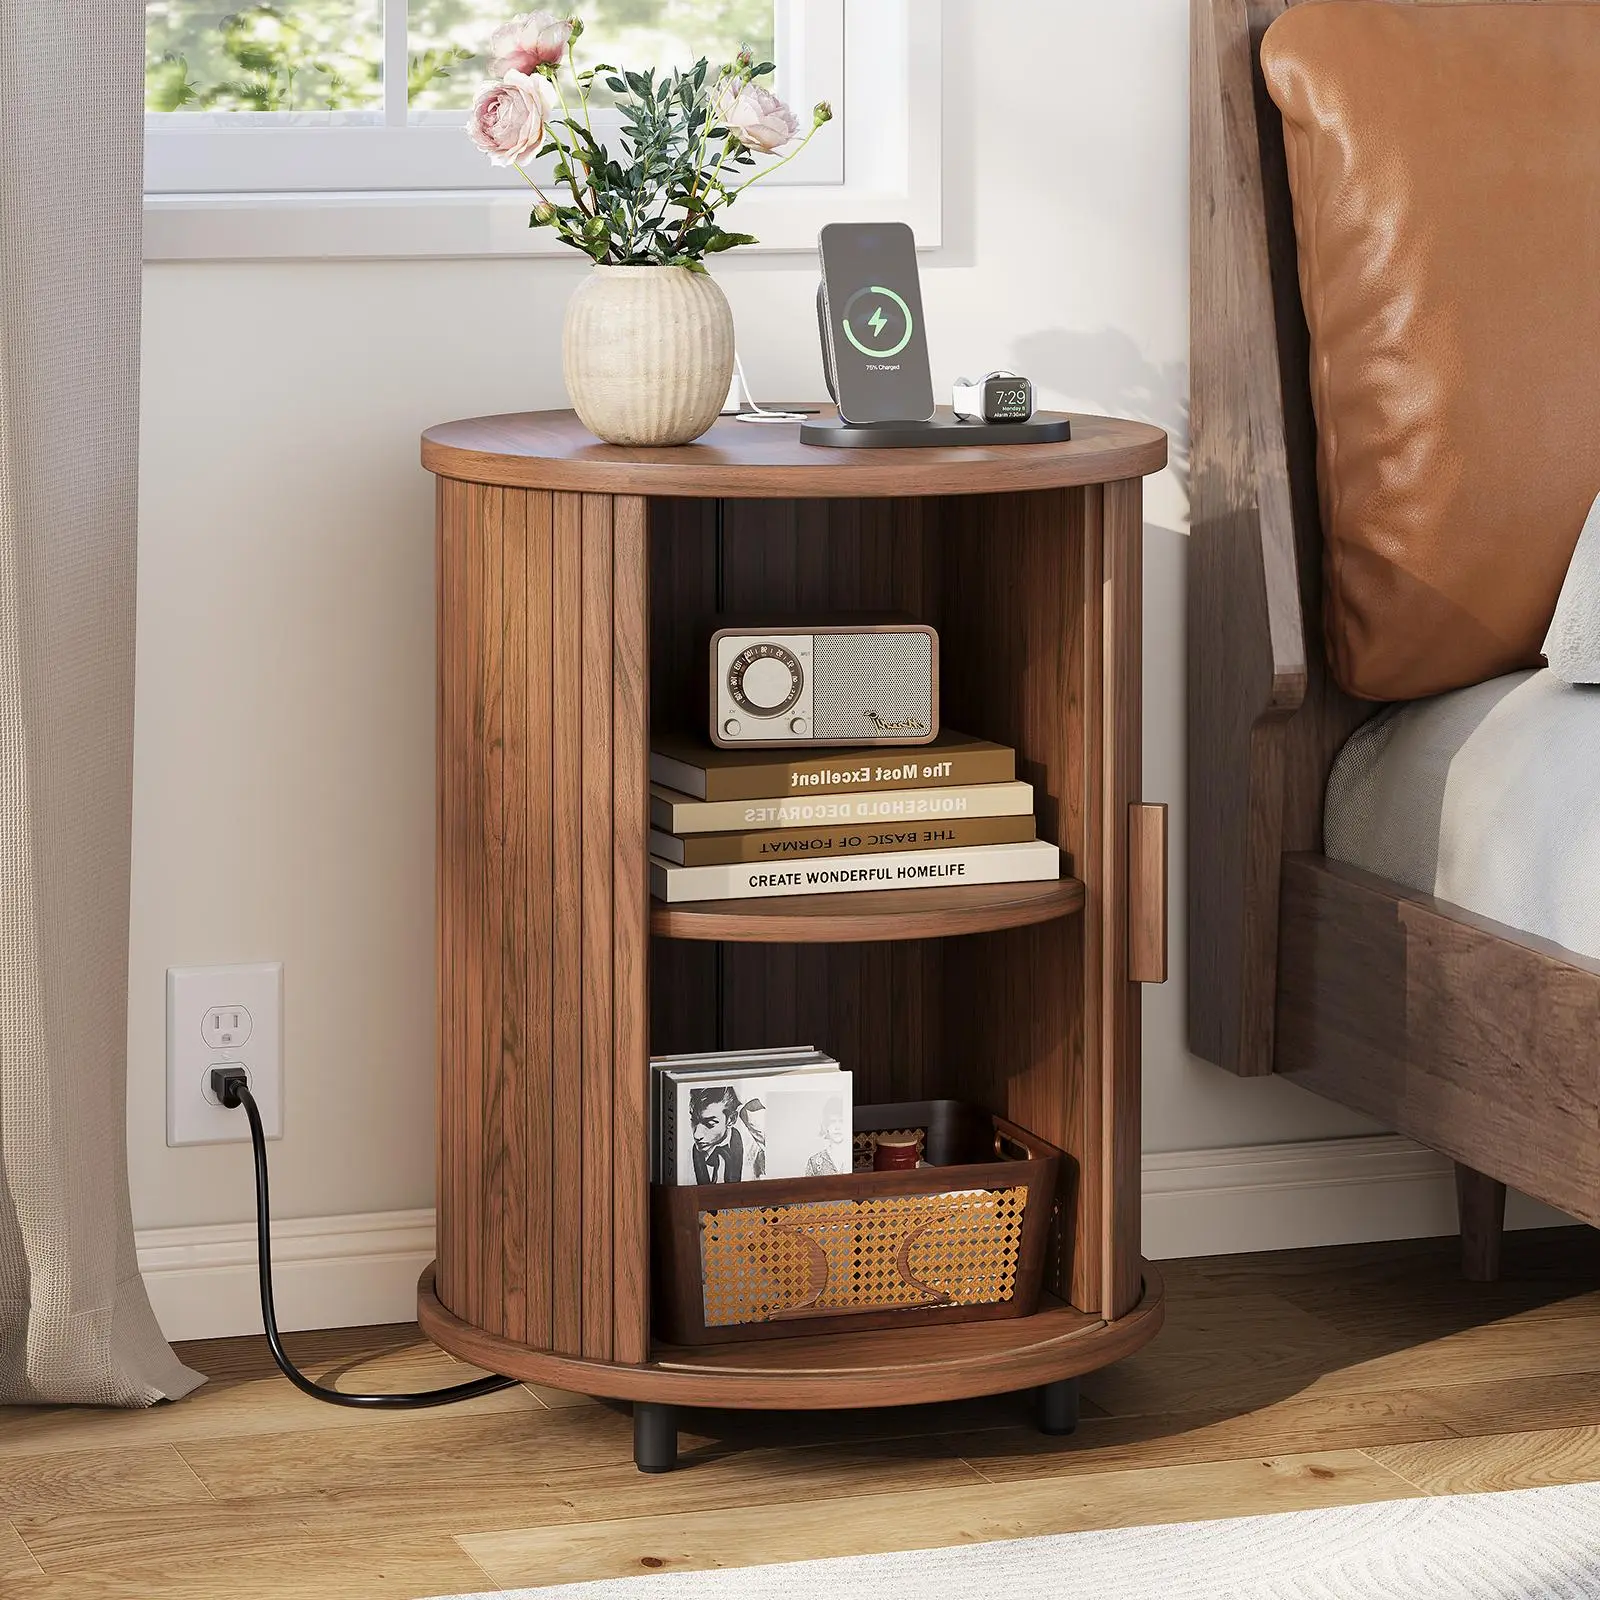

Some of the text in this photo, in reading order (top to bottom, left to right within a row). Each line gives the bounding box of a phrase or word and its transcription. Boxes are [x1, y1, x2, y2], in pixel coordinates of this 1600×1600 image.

[996, 390, 1026, 405] 7:29
[759, 830, 956, 854] THE BASIC OF FORMAT
[749, 863, 966, 888] CREATE WONDERFUL HOMELIFE
